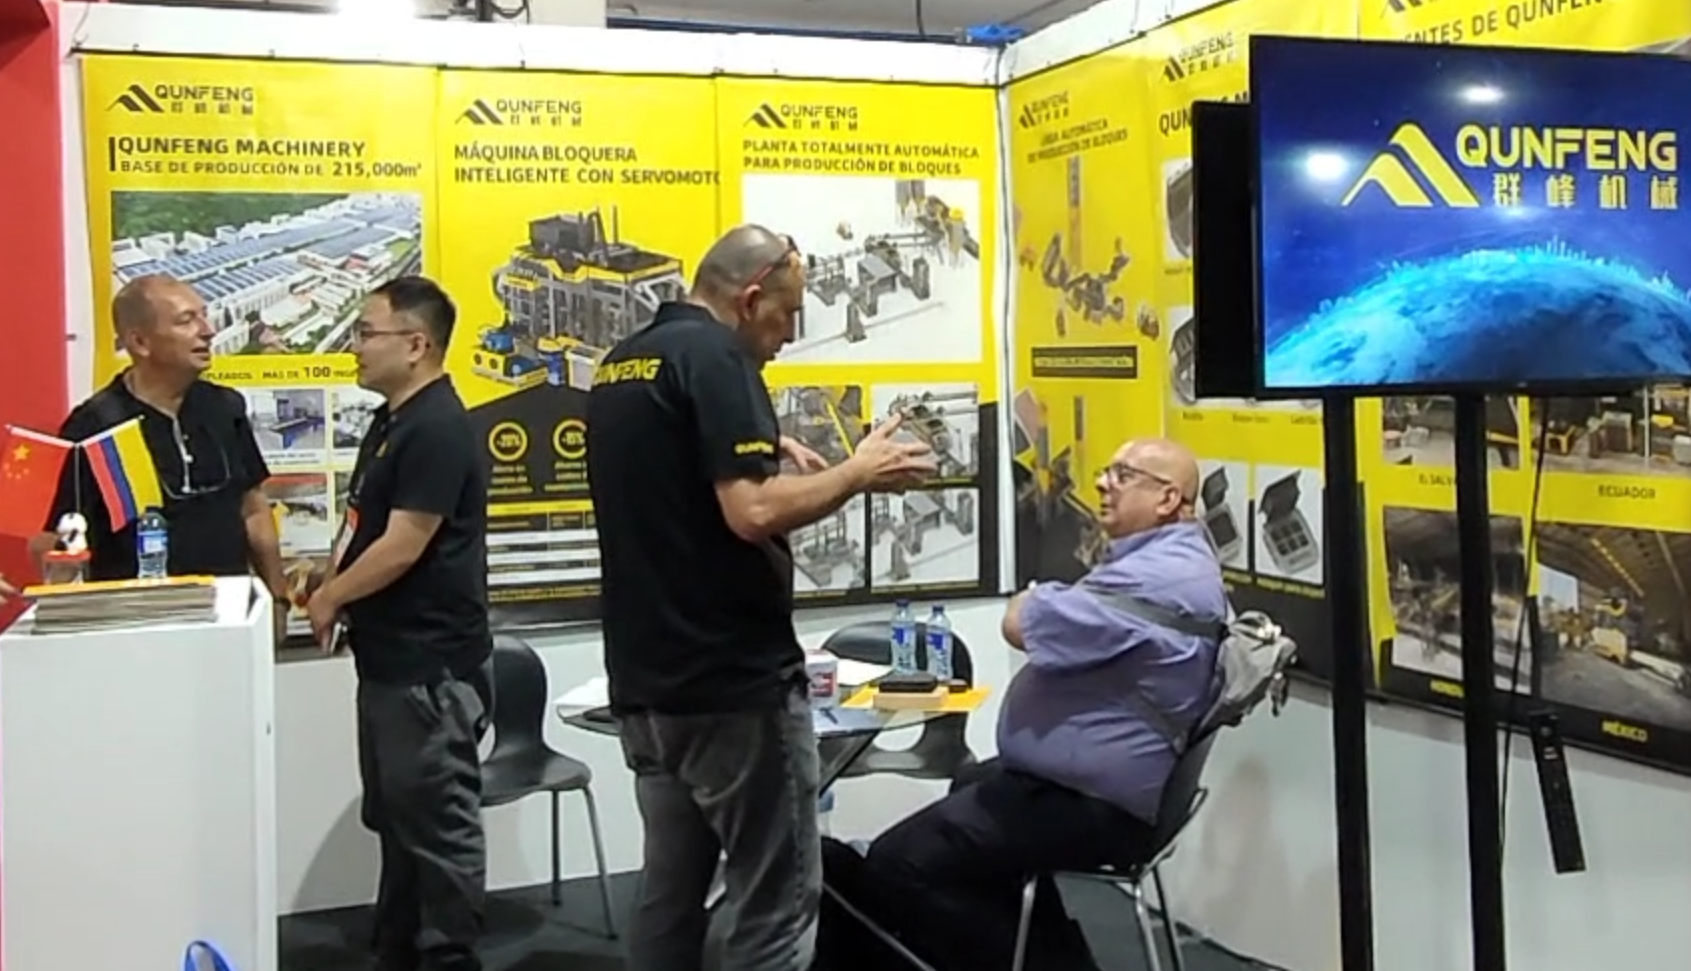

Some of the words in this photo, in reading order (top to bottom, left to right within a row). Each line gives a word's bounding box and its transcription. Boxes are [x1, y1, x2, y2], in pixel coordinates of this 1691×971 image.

[1472, 10, 1497, 36] DE
[154, 84, 254, 101] QUNFENG
[497, 99, 582, 114] QUNFENG
[780, 104, 858, 119] QUNFENG
[118, 136, 229, 155] QUNFENG
[236, 140, 366, 157] MACHINERY
[454, 141, 539, 163] MÁQUINA
[542, 146, 638, 164] BLOQUERA
[743, 140, 797, 154] PLANTA
[801, 141, 890, 156] TOTALMENTE
[894, 142, 980, 159] AUTOMÁTICA
[1455, 124, 1677, 171] QUNFENG
[121, 160, 163, 174] BASE
[169, 161, 188, 174] DE
[194, 160, 299, 176] PRODUCCIÓN
[304, 164, 323, 176] DE
[744, 156, 780, 169] PARA
[783, 157, 875, 173] PRODUCCIÓN
[878, 160, 895, 172] DE
[899, 161, 961, 176] BLOQUES
[454, 167, 570, 183] INTELIGENTE
[577, 168, 613, 184] CON
[1493, 172, 1678, 210] 群峰机械
[304, 366, 331, 378] 100
[1598, 484, 1656, 499] ECUADOR
